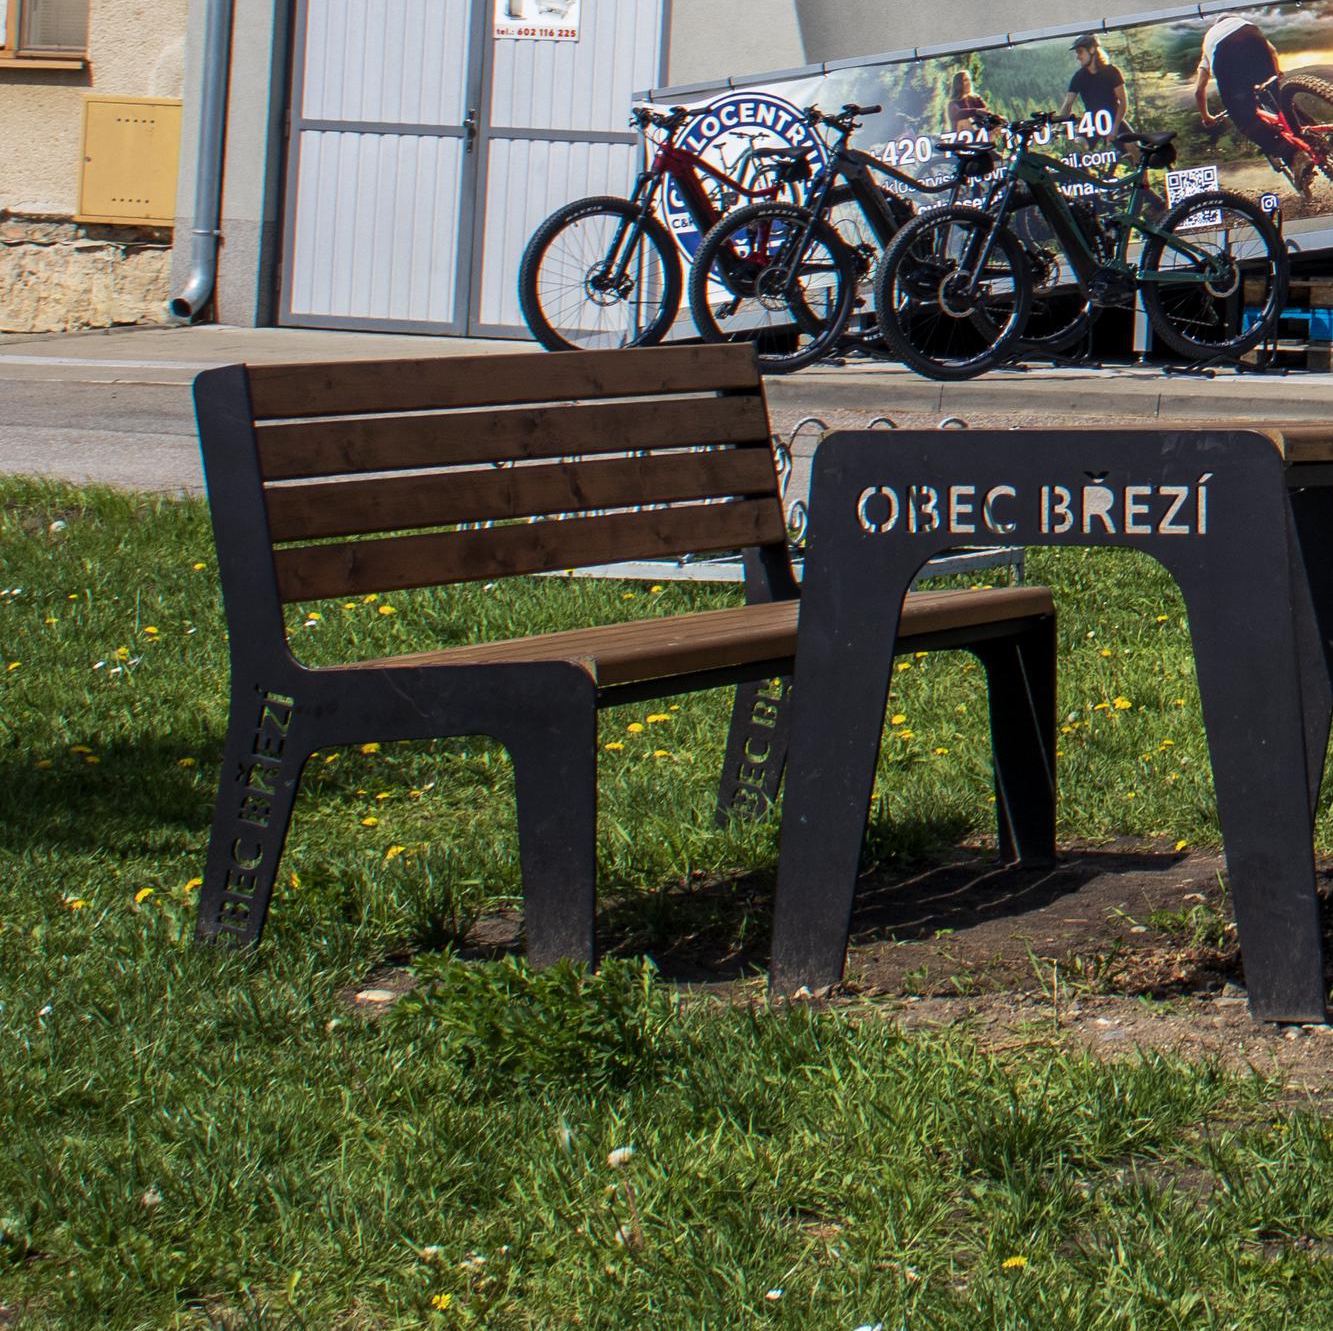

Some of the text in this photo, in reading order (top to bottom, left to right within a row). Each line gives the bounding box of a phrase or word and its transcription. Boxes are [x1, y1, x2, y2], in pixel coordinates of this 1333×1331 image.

[517, 28, 536, 36] 602
[539, 28, 555, 37] 116
[558, 29, 576, 37] 225
[855, 471, 1214, 536] OBEC BŘEZÍ
